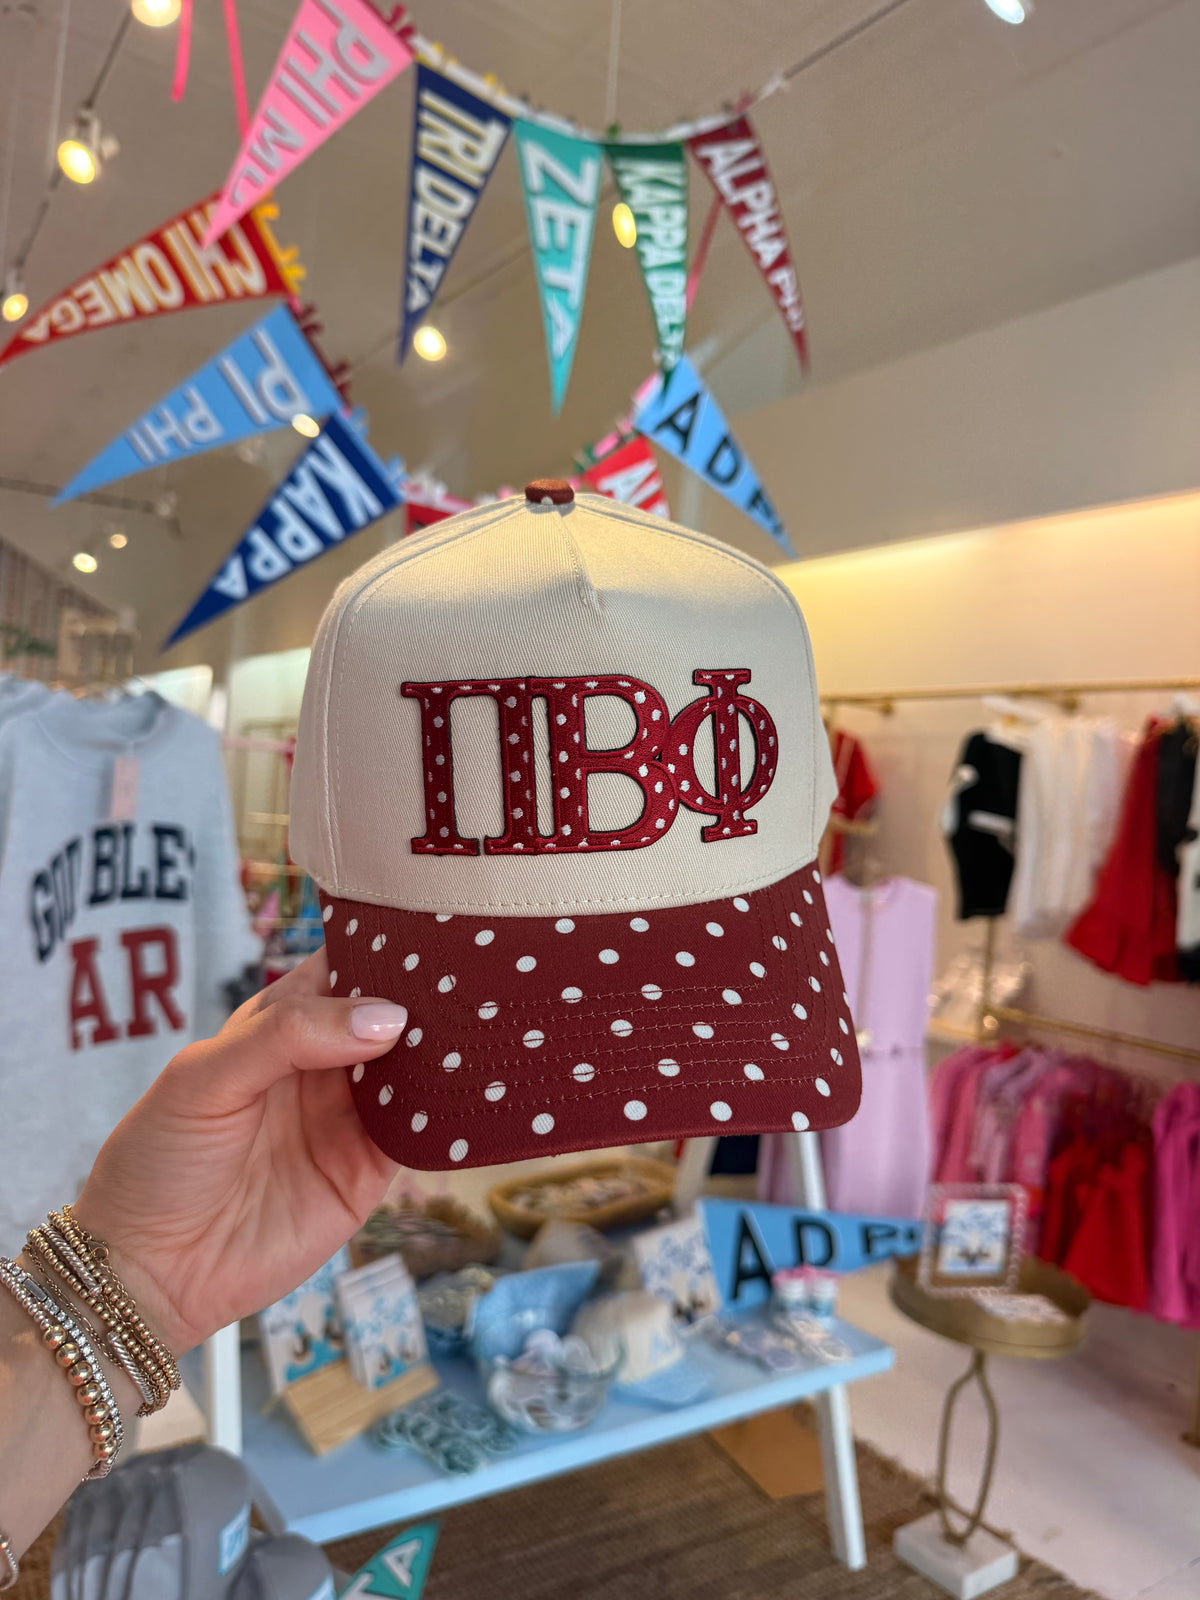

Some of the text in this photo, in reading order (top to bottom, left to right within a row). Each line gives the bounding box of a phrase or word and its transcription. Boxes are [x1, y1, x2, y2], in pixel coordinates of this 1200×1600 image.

[232, 0, 390, 206] PHI MU
[407, 91, 508, 313] TRI DELTA
[521, 140, 599, 360] ZETA
[613, 158, 687, 269] KAPPA
[698, 138, 787, 268] ALPHA
[22, 203, 266, 342] CHI OMEGA
[127, 326, 314, 464] PI PHI
[212, 433, 384, 599] KAPPA
[68, 923, 187, 1053] AR
